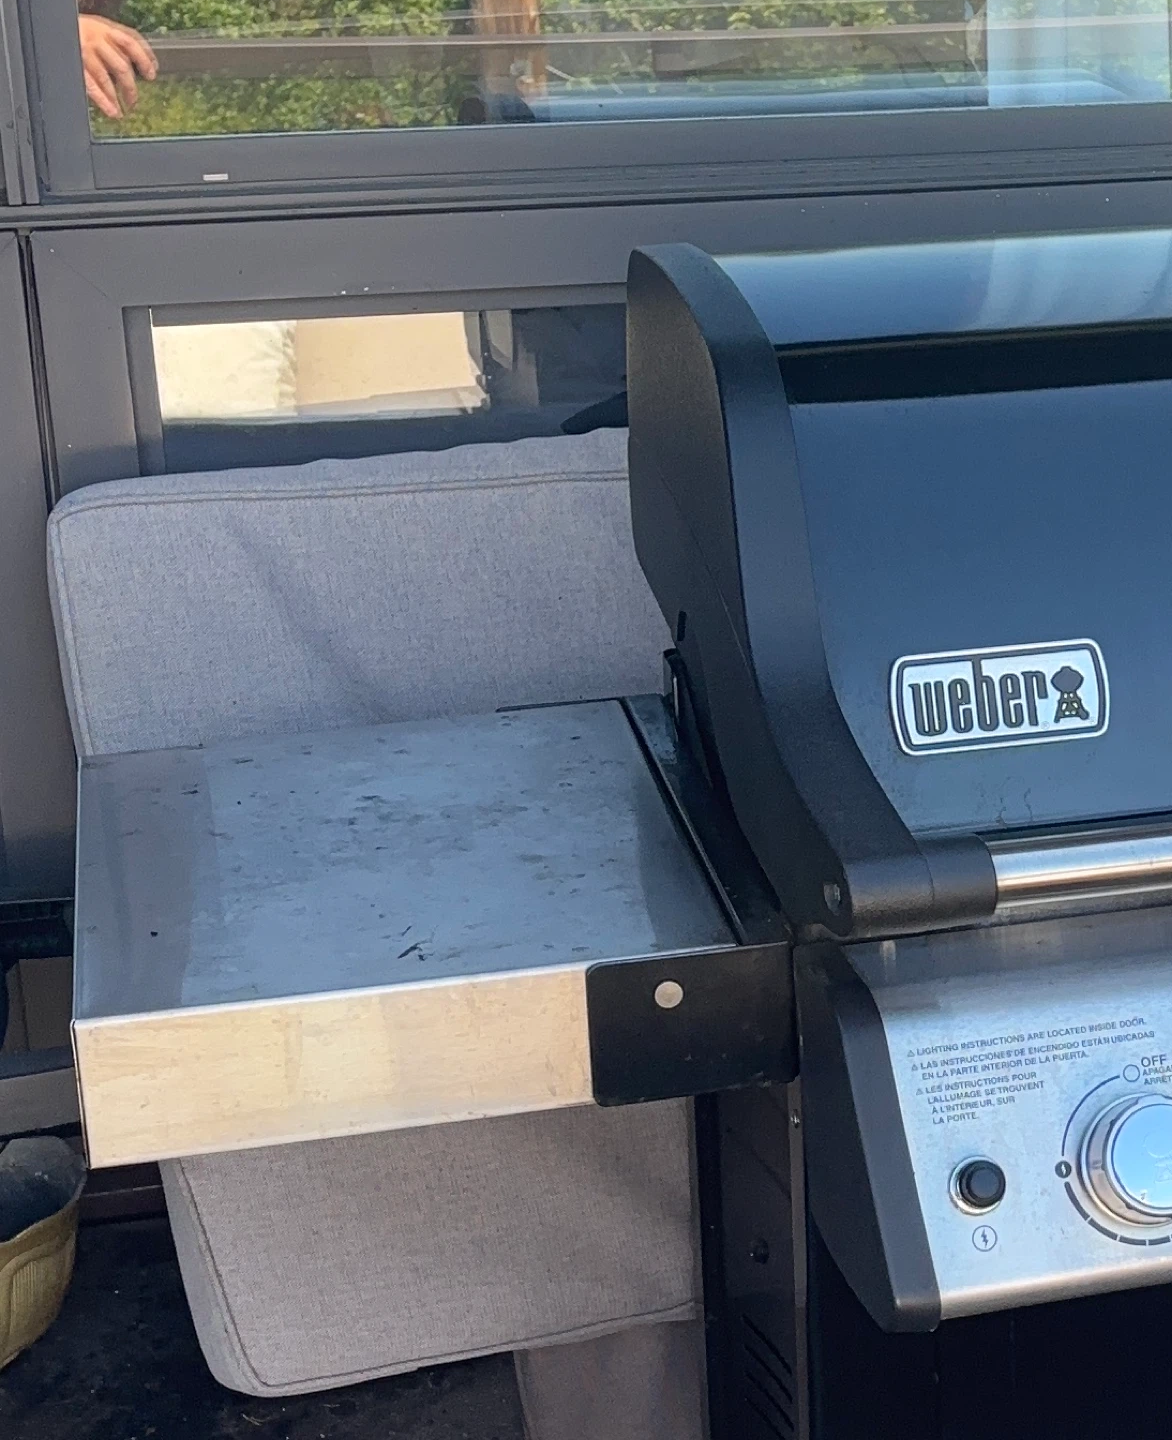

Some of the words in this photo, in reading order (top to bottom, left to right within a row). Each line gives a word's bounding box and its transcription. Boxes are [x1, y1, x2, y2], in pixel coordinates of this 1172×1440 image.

[908, 659, 1048, 736] weber
[917, 1043, 959, 1056] LIGHTING
[961, 1033, 1025, 1049] INSTRUCTIONS
[1027, 1031, 1045, 1041] ARE
[1047, 1026, 1087, 1038] LOCATED
[1088, 1021, 1117, 1033] INSIDE
[920, 1060, 938, 1070] LAS
[940, 1049, 1012, 1067] INSTRUCCIONES
[1014, 1047, 1026, 1057] DE
[1028, 1041, 1080, 1055] ENCENDIDO
[1141, 1054, 1167, 1067] OFF
[922, 1072, 934, 1081] EN
[936, 1070, 949, 1079] LA
[950, 1065, 979, 1076] PARTE
[981, 1059, 1023, 1072] INTERIOR
[1025, 1056, 1037, 1066] DE
[1039, 1054, 1051, 1064] LA
[925, 1085, 943, 1094] LES
[945, 1075, 1009, 1091] INSTRUCTIONS
[1011, 1071, 1037, 1081] POUR
[984, 1087, 996, 1096] SE
[998, 1080, 1045, 1094] TROUVENT
[997, 1095, 1016, 1105] SUR
[932, 1116, 945, 1125] LA
